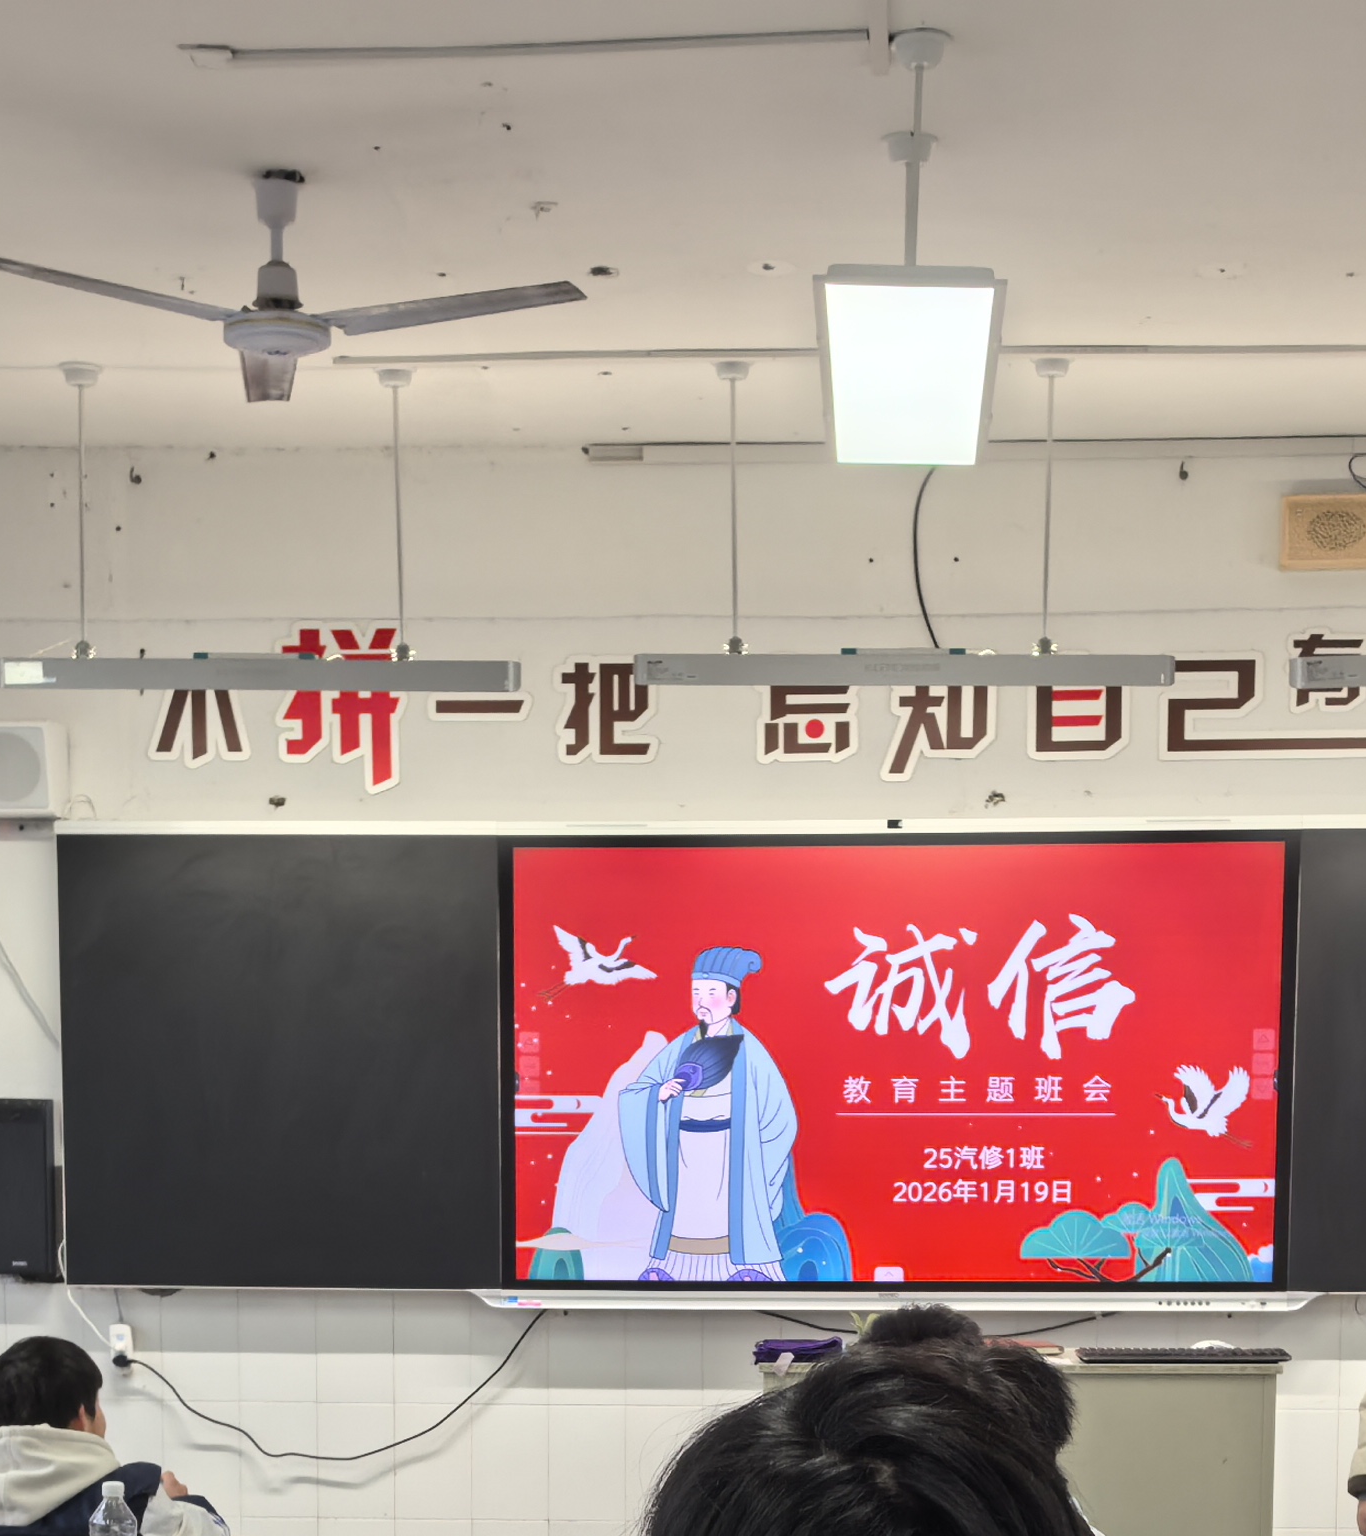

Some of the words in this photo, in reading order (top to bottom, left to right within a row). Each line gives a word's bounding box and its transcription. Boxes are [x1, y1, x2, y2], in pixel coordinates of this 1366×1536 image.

[824, 914, 1137, 1060] 诚信
[842, 1075, 1112, 1104] 教育主题班会
[923, 1146, 1045, 1170] 25汽修1班
[892, 1179, 1073, 1204] 2026年1月19日
